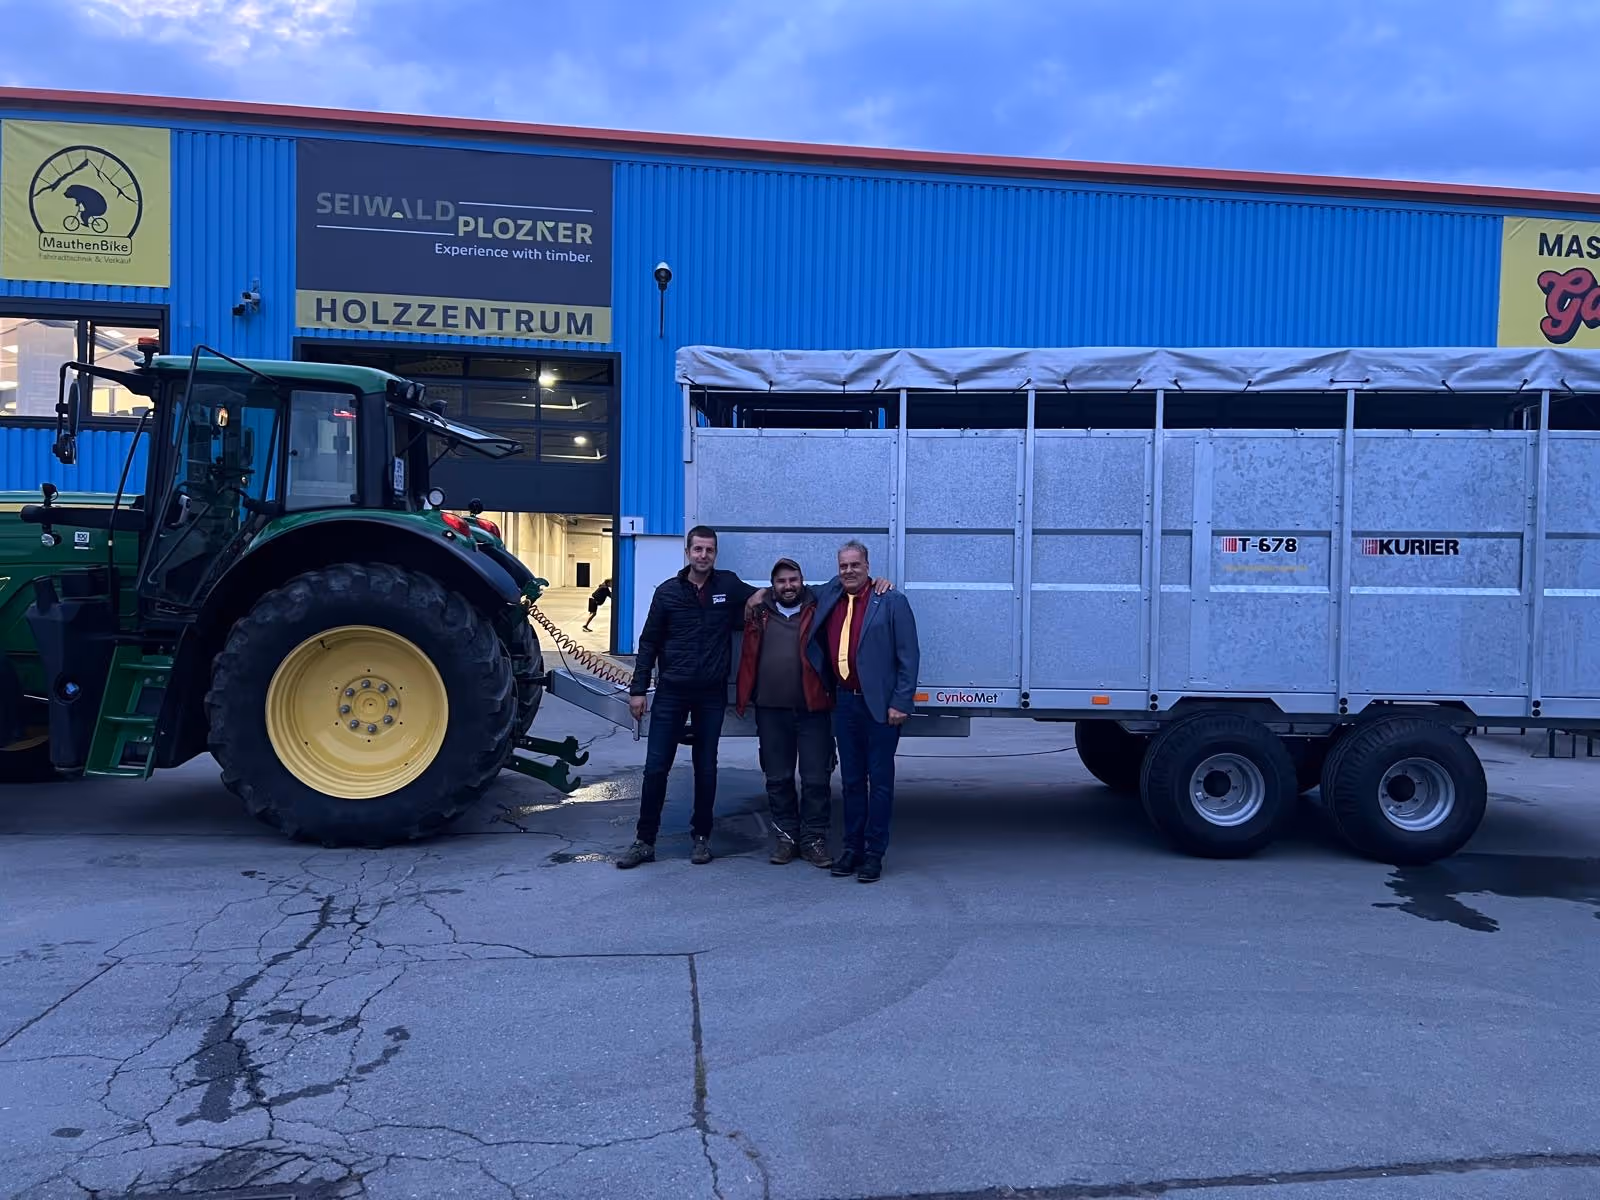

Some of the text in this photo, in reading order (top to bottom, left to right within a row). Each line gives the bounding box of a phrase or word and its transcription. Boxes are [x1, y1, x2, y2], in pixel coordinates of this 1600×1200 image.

[316, 192, 455, 221] SEIWALD
[43, 237, 128, 251] MauthenBike
[435, 243, 593, 263] Experience with timber.
[315, 297, 593, 336] HOLZZENTRUM
[629, 520, 635, 531] 1
[1238, 537, 1298, 553] T-678
[1379, 538, 1460, 556] KURIER
[936, 691, 998, 705] CynkoMet
